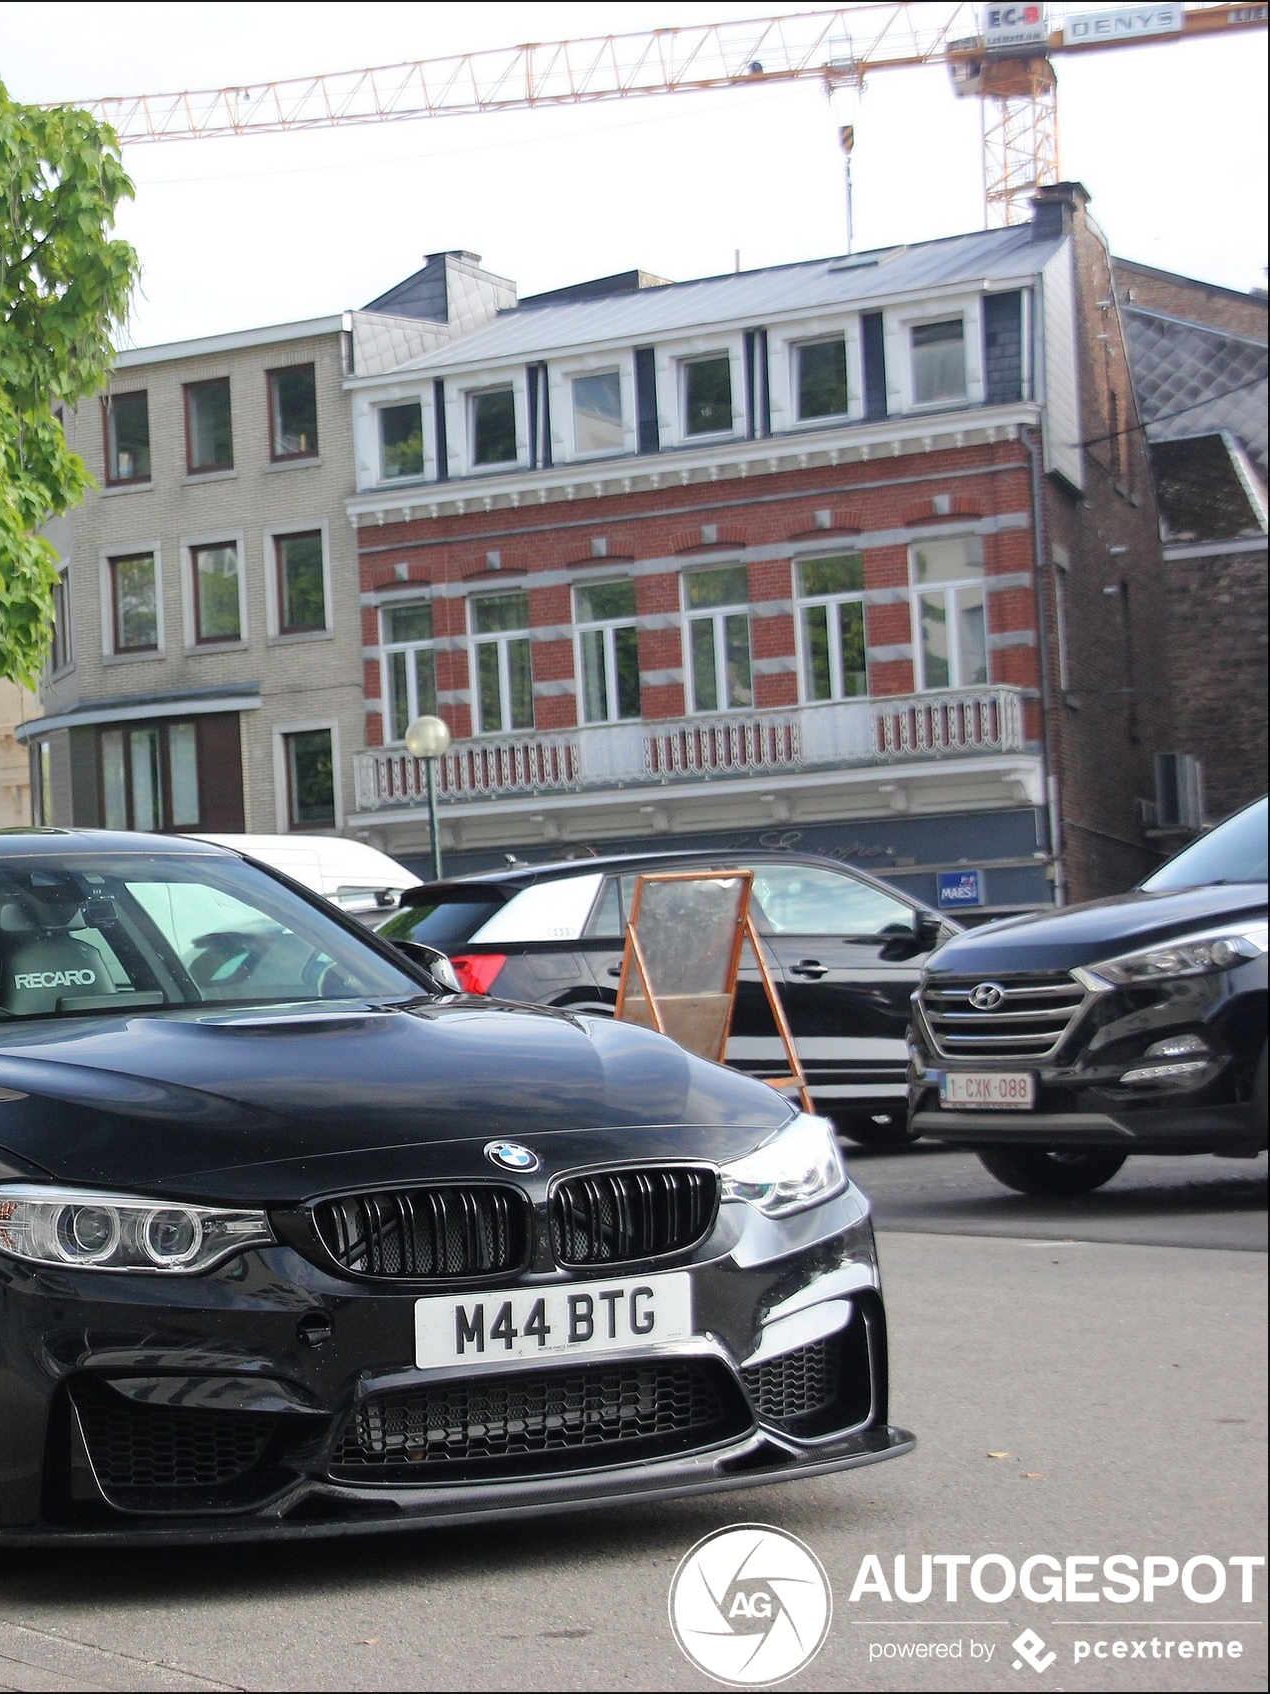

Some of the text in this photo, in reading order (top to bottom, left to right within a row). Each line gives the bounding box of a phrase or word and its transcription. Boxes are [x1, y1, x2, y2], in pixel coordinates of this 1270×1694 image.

[988, 6, 1039, 28] EC-B
[1071, 11, 1173, 38] DENYS
[941, 886, 972, 900] MAES
[14, 968, 96, 990] RECARO
[455, 1285, 656, 1355] M44 BTG
